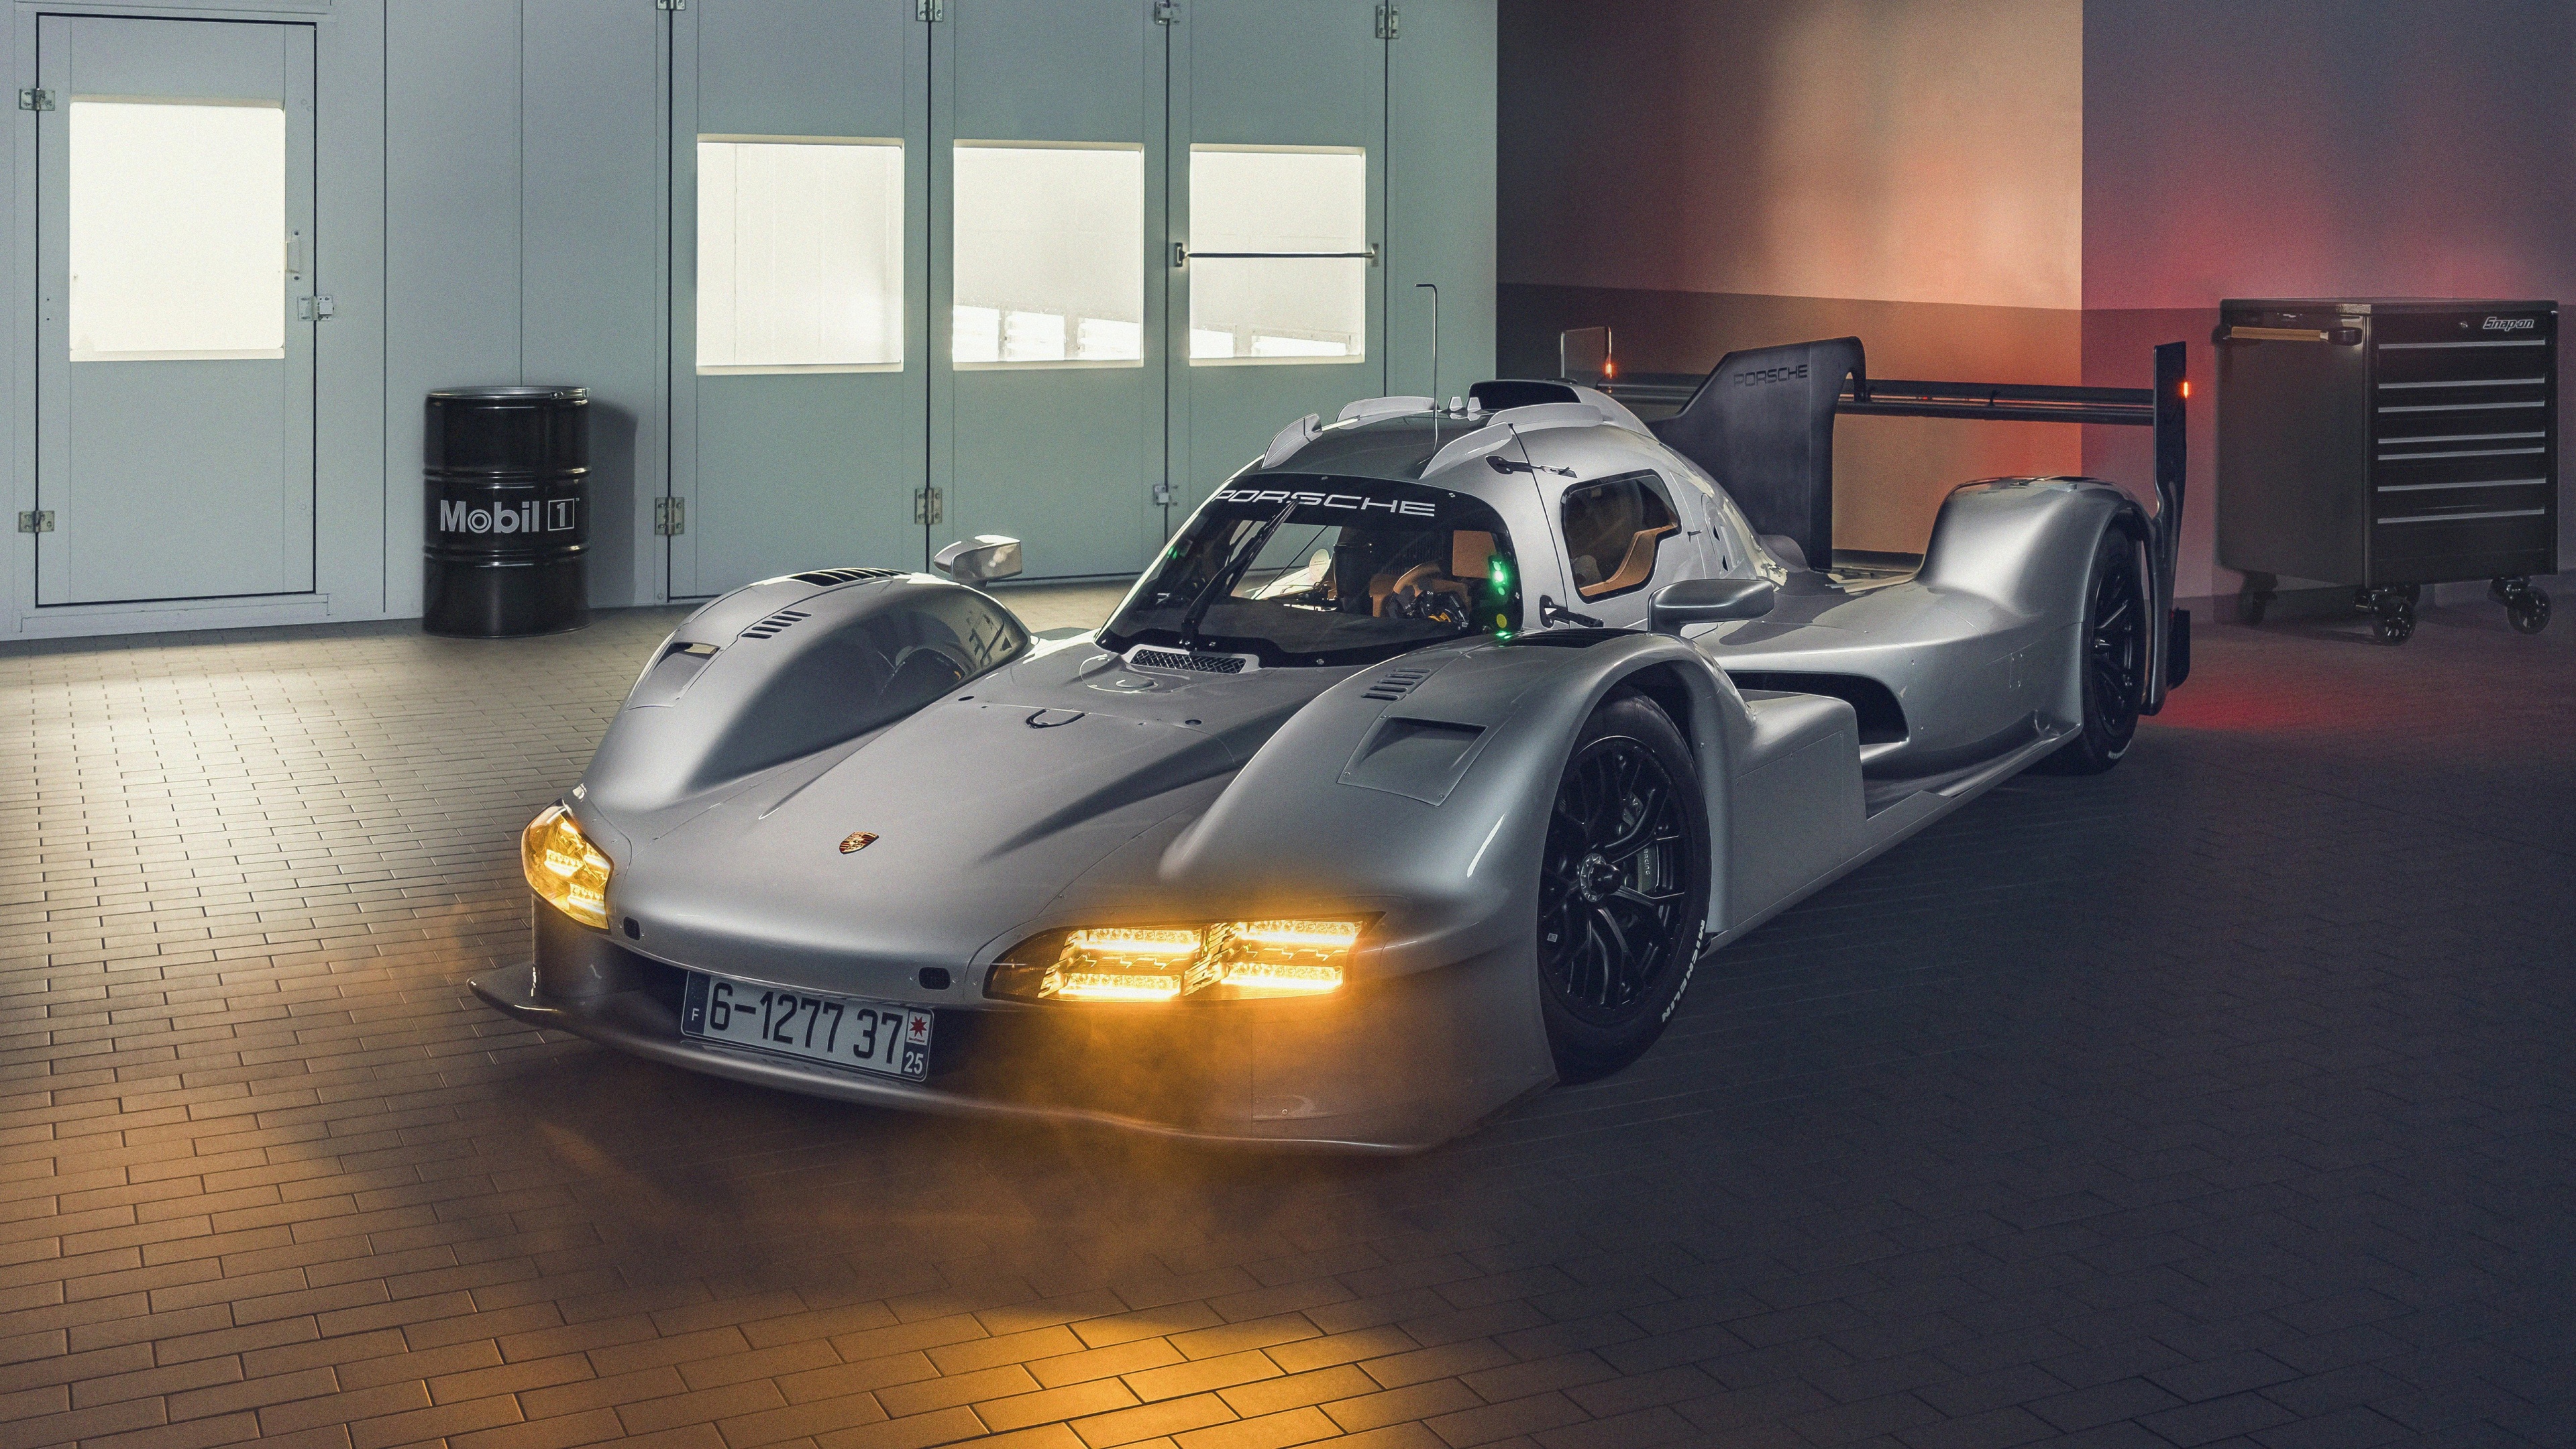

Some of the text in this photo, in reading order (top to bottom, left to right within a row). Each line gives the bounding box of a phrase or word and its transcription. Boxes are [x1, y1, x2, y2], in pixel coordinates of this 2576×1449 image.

[2482, 316, 2534, 332] Snap-on
[1733, 364, 1808, 386] PORSCHE
[440, 499, 540, 533] Mobil
[1212, 489, 1436, 517] PORSCHE
[1662, 919, 1705, 1023] MICHELIN
[692, 1008, 700, 1021] F
[710, 982, 904, 1065] 6-1277 37
[904, 1051, 924, 1075] 25
